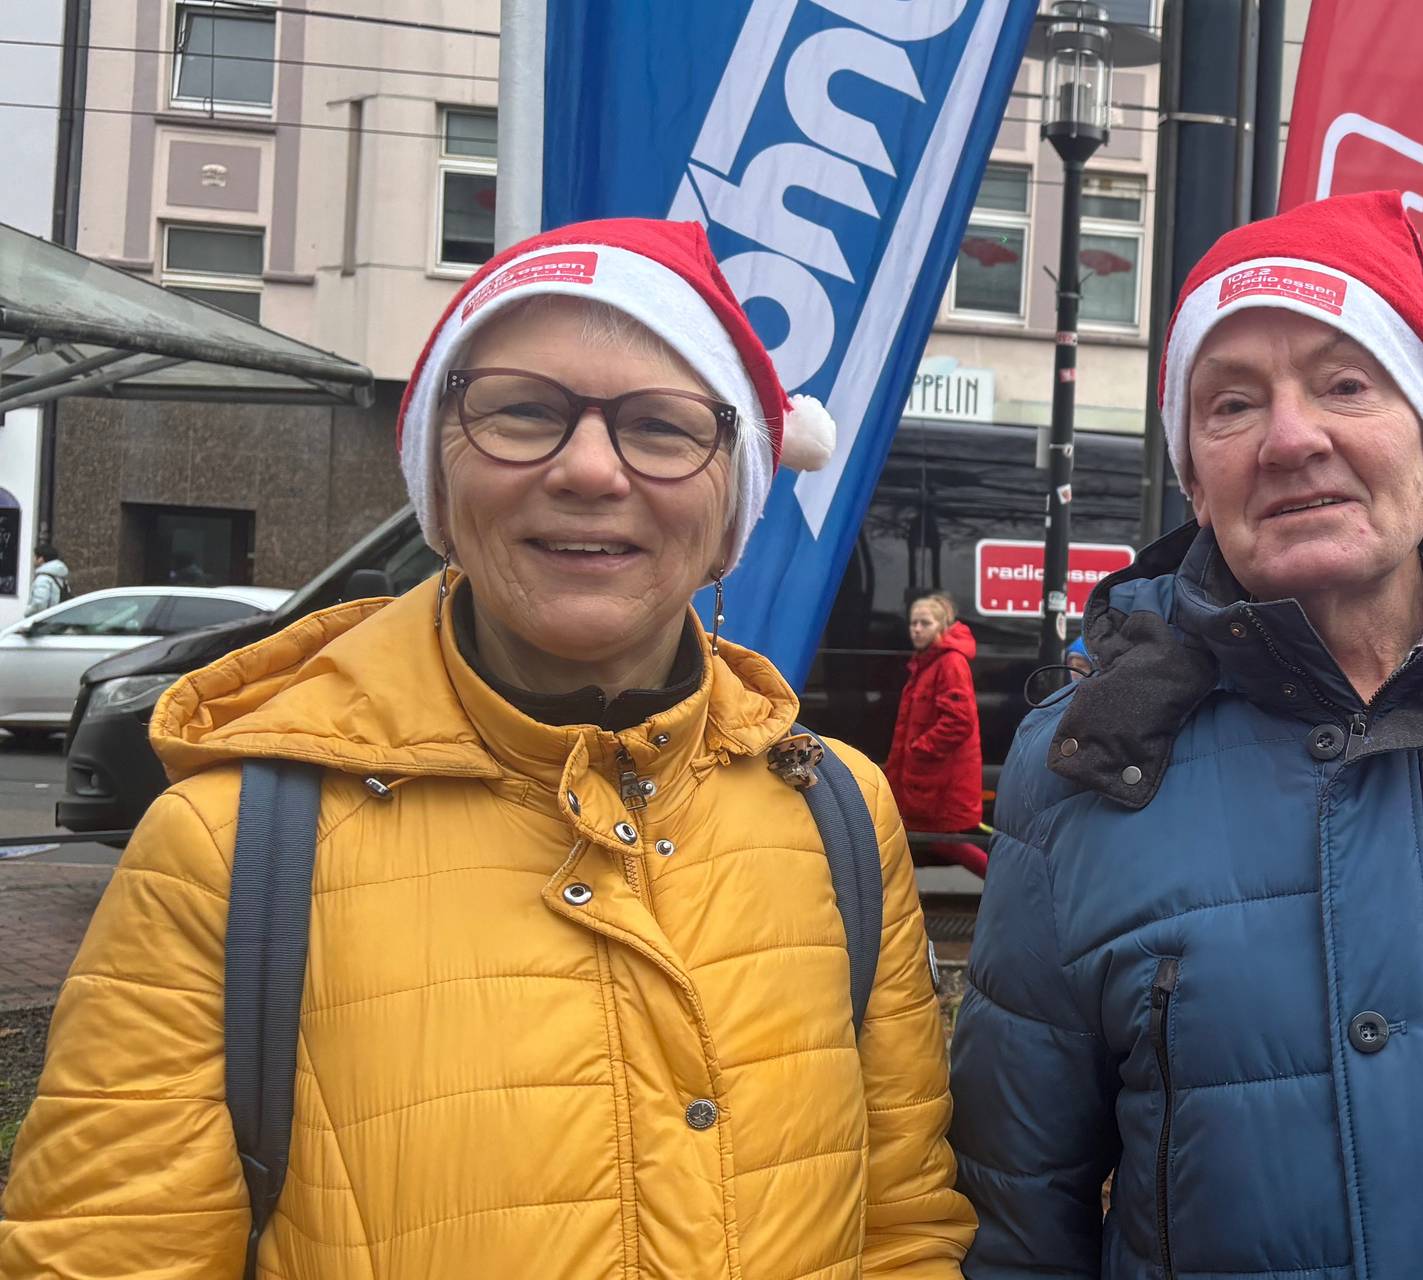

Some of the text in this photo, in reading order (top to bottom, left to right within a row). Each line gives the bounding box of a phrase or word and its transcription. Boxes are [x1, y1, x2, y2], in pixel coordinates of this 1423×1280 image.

[518, 262, 585, 276] essen
[1227, 268, 1272, 285] 102.2
[1232, 275, 1337, 297] radio essen
